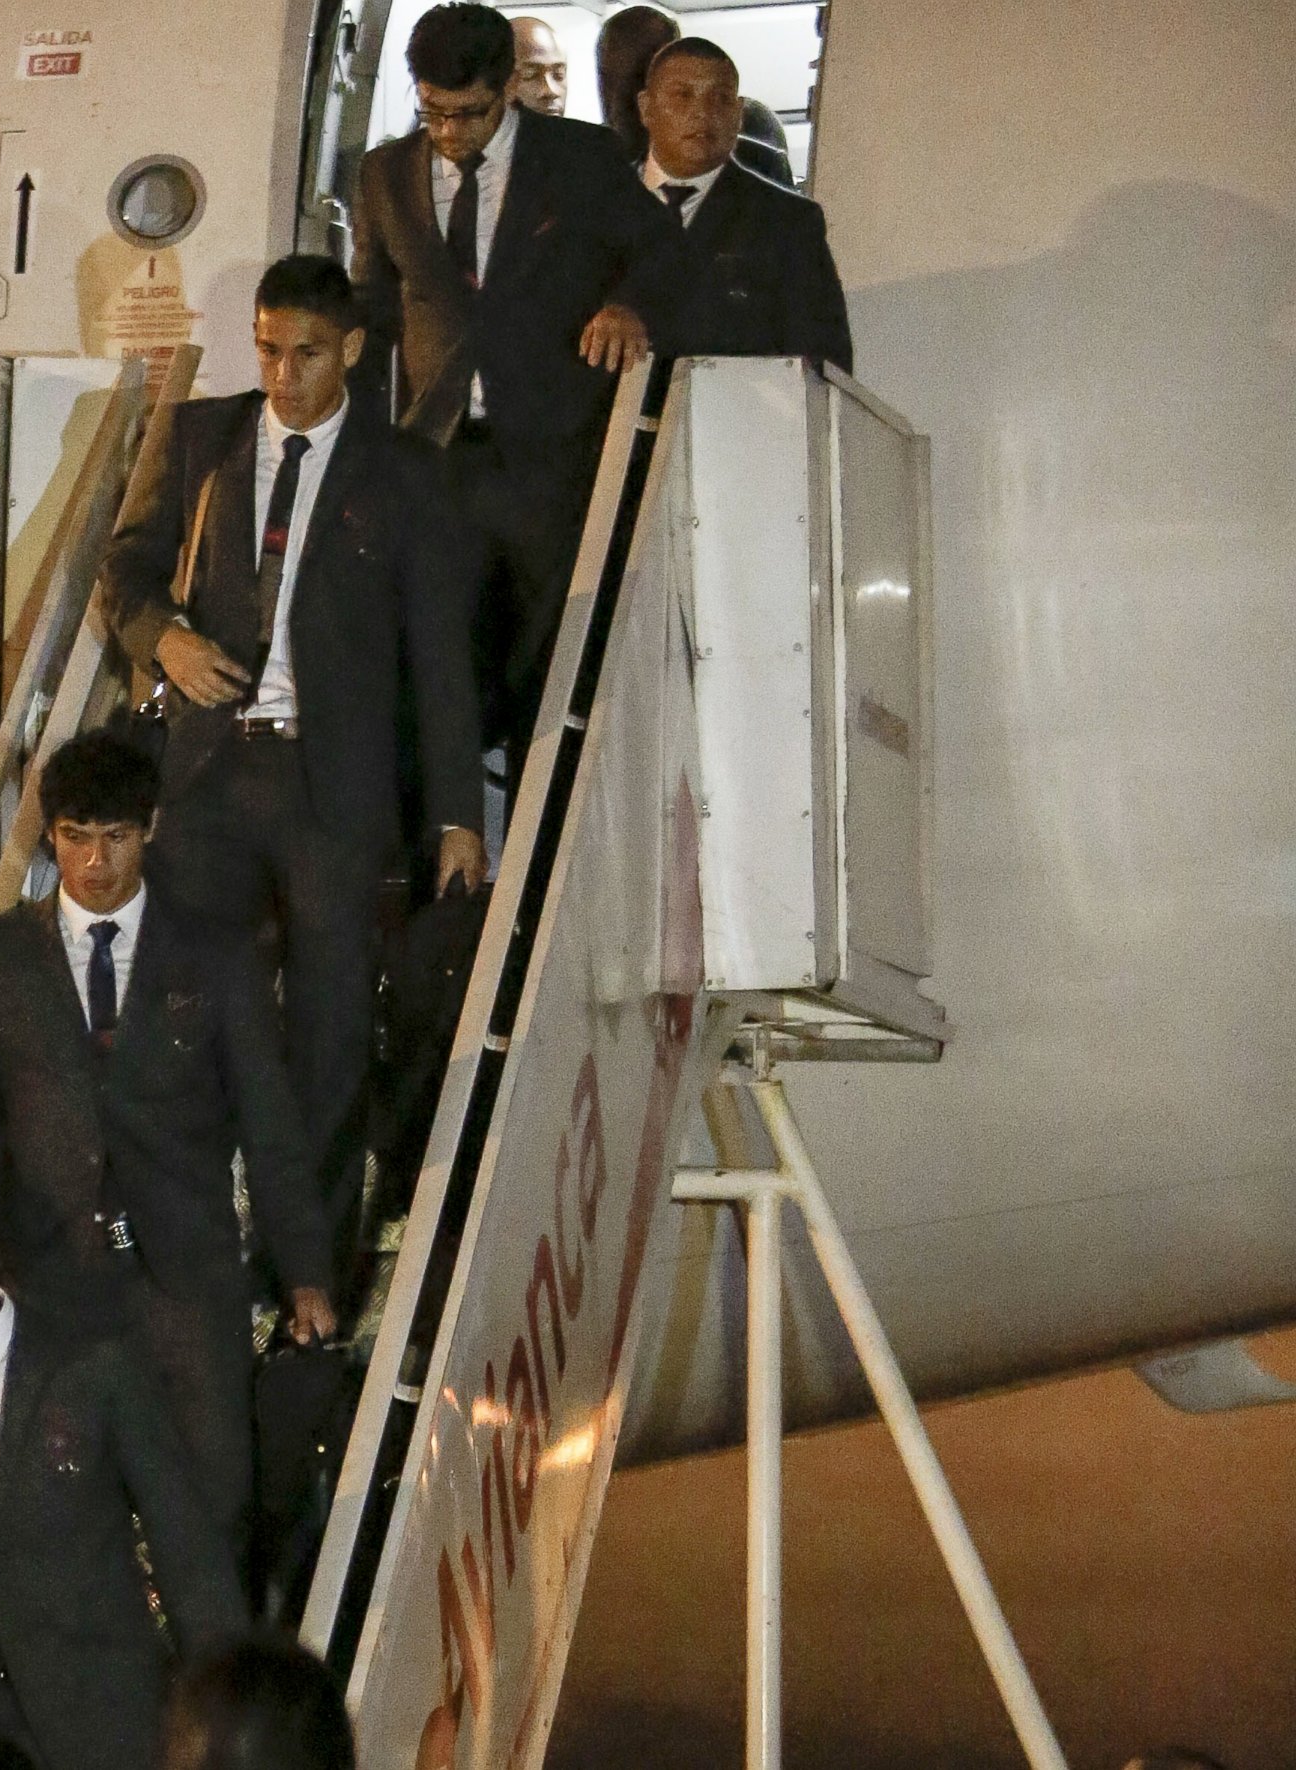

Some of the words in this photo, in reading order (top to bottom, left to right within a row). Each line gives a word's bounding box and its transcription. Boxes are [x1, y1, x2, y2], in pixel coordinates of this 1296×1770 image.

[23, 29, 92, 46] SALIDA
[31, 55, 75, 73] EXIT
[122, 286, 179, 299] PELIGRO
